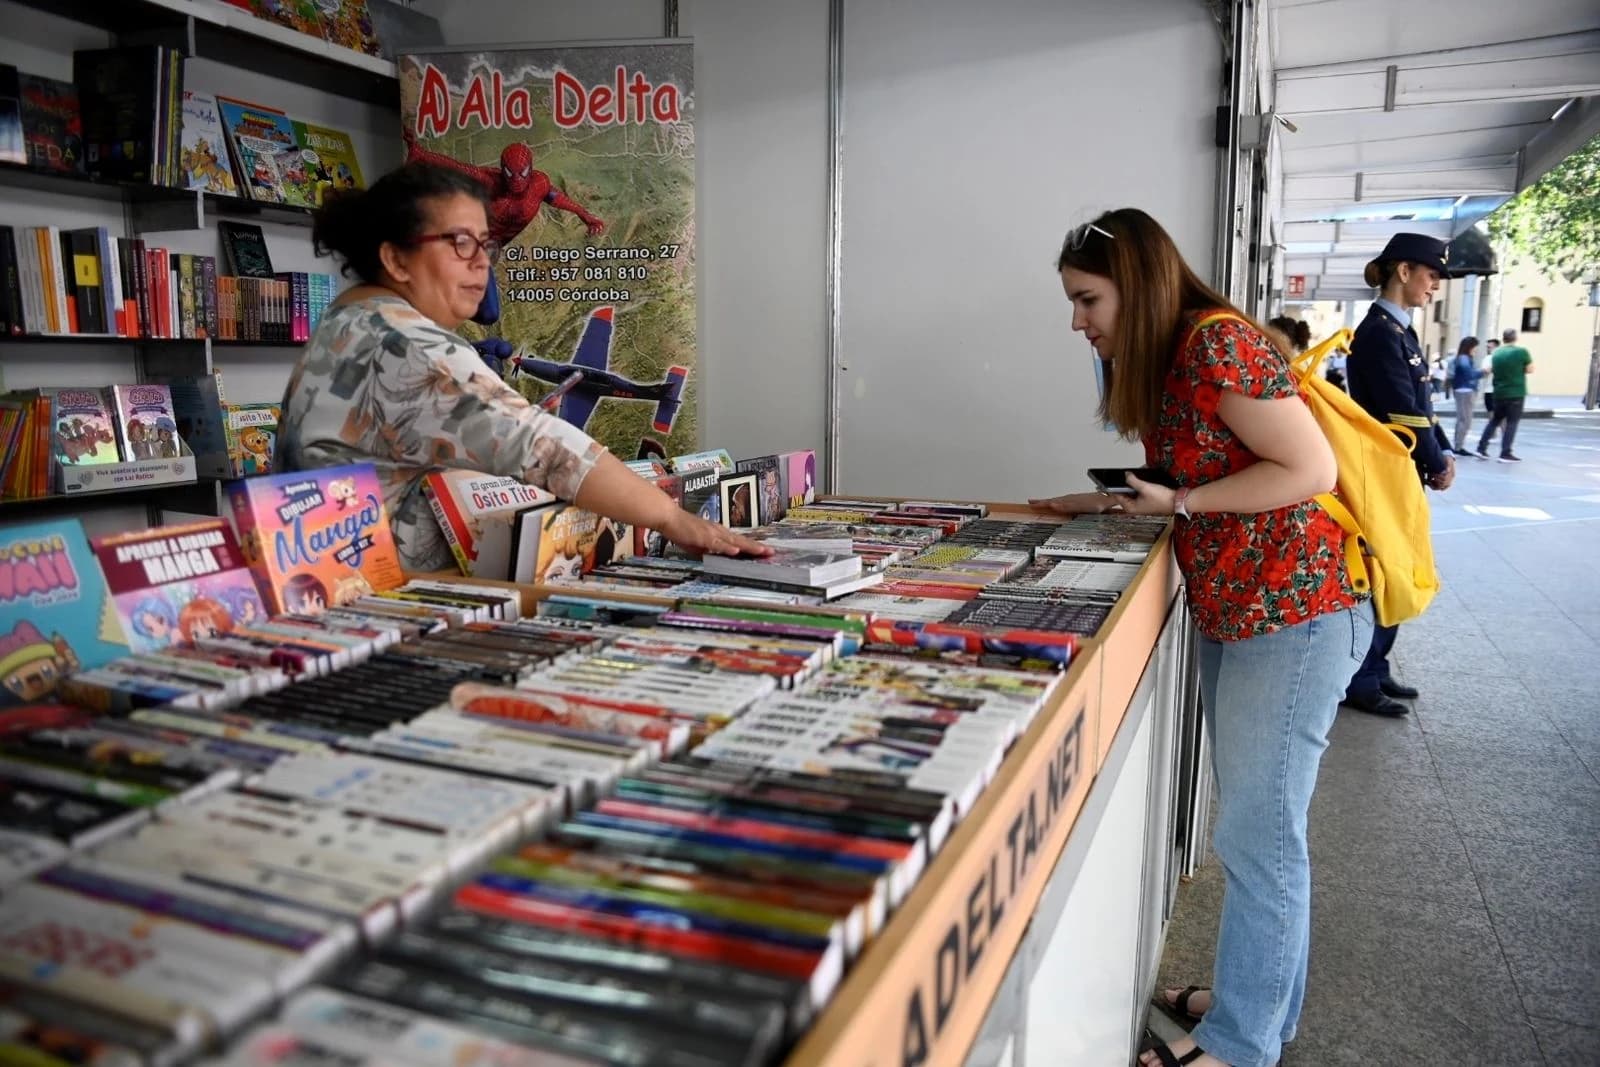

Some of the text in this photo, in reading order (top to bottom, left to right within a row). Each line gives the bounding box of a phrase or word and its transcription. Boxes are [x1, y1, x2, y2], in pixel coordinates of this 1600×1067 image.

[458, 70, 532, 128] Ala
[553, 65, 680, 128] Delta
[532, 246, 580, 263] Diego
[584, 245, 654, 262] Serrano,
[659, 244, 680, 258] 27
[507, 266, 646, 281] Telf.: 957 081 810
[507, 286, 630, 302] 14005 Córdoba
[470, 482, 480, 491] El
[480, 480, 500, 490] gran
[280, 493, 323, 521] DIBUJAR
[472, 486, 537, 510] Osito Tito
[275, 494, 380, 573] Manga
[141, 547, 220, 585] MANGA
